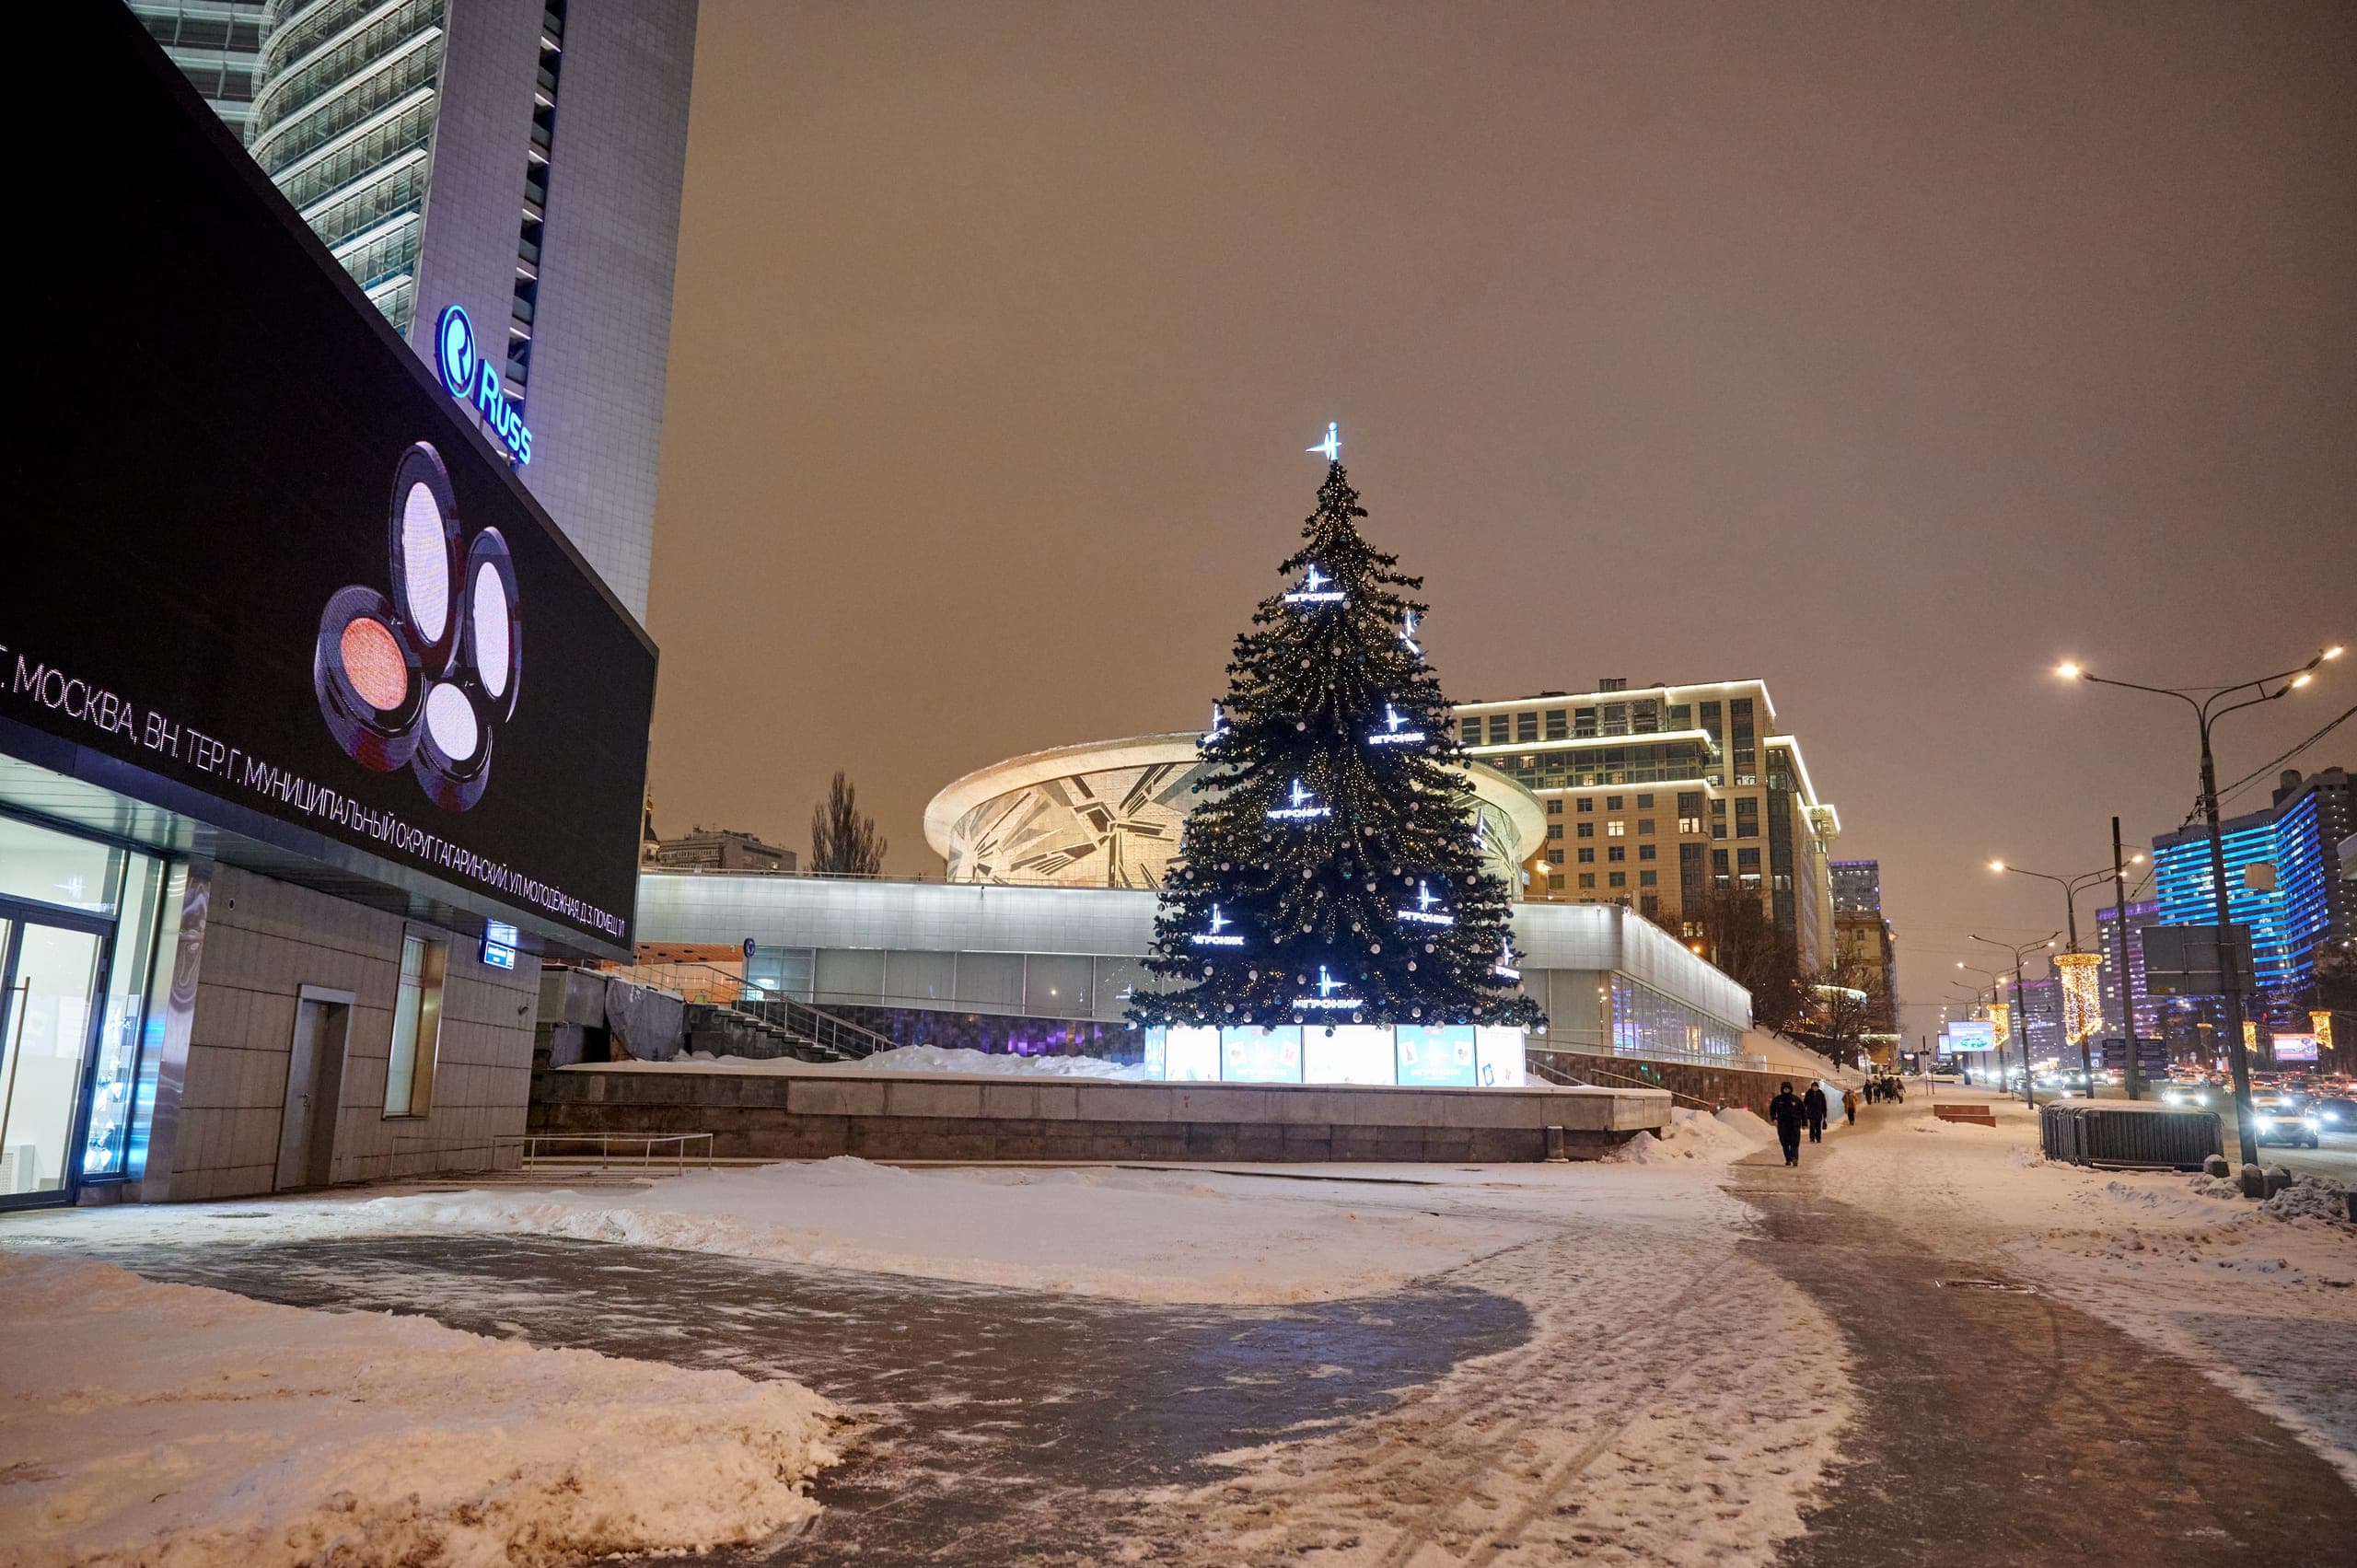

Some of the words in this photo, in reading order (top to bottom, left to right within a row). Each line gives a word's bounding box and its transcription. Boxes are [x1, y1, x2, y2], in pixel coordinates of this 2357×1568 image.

[13, 653, 137, 744] МОСКВА,
[244, 756, 395, 844] МУНИЦИПАЛЬНЫЙ
[396, 822, 435, 859] ОКРУГ
[435, 838, 508, 891] ГАГАРИНСКИЙ,
